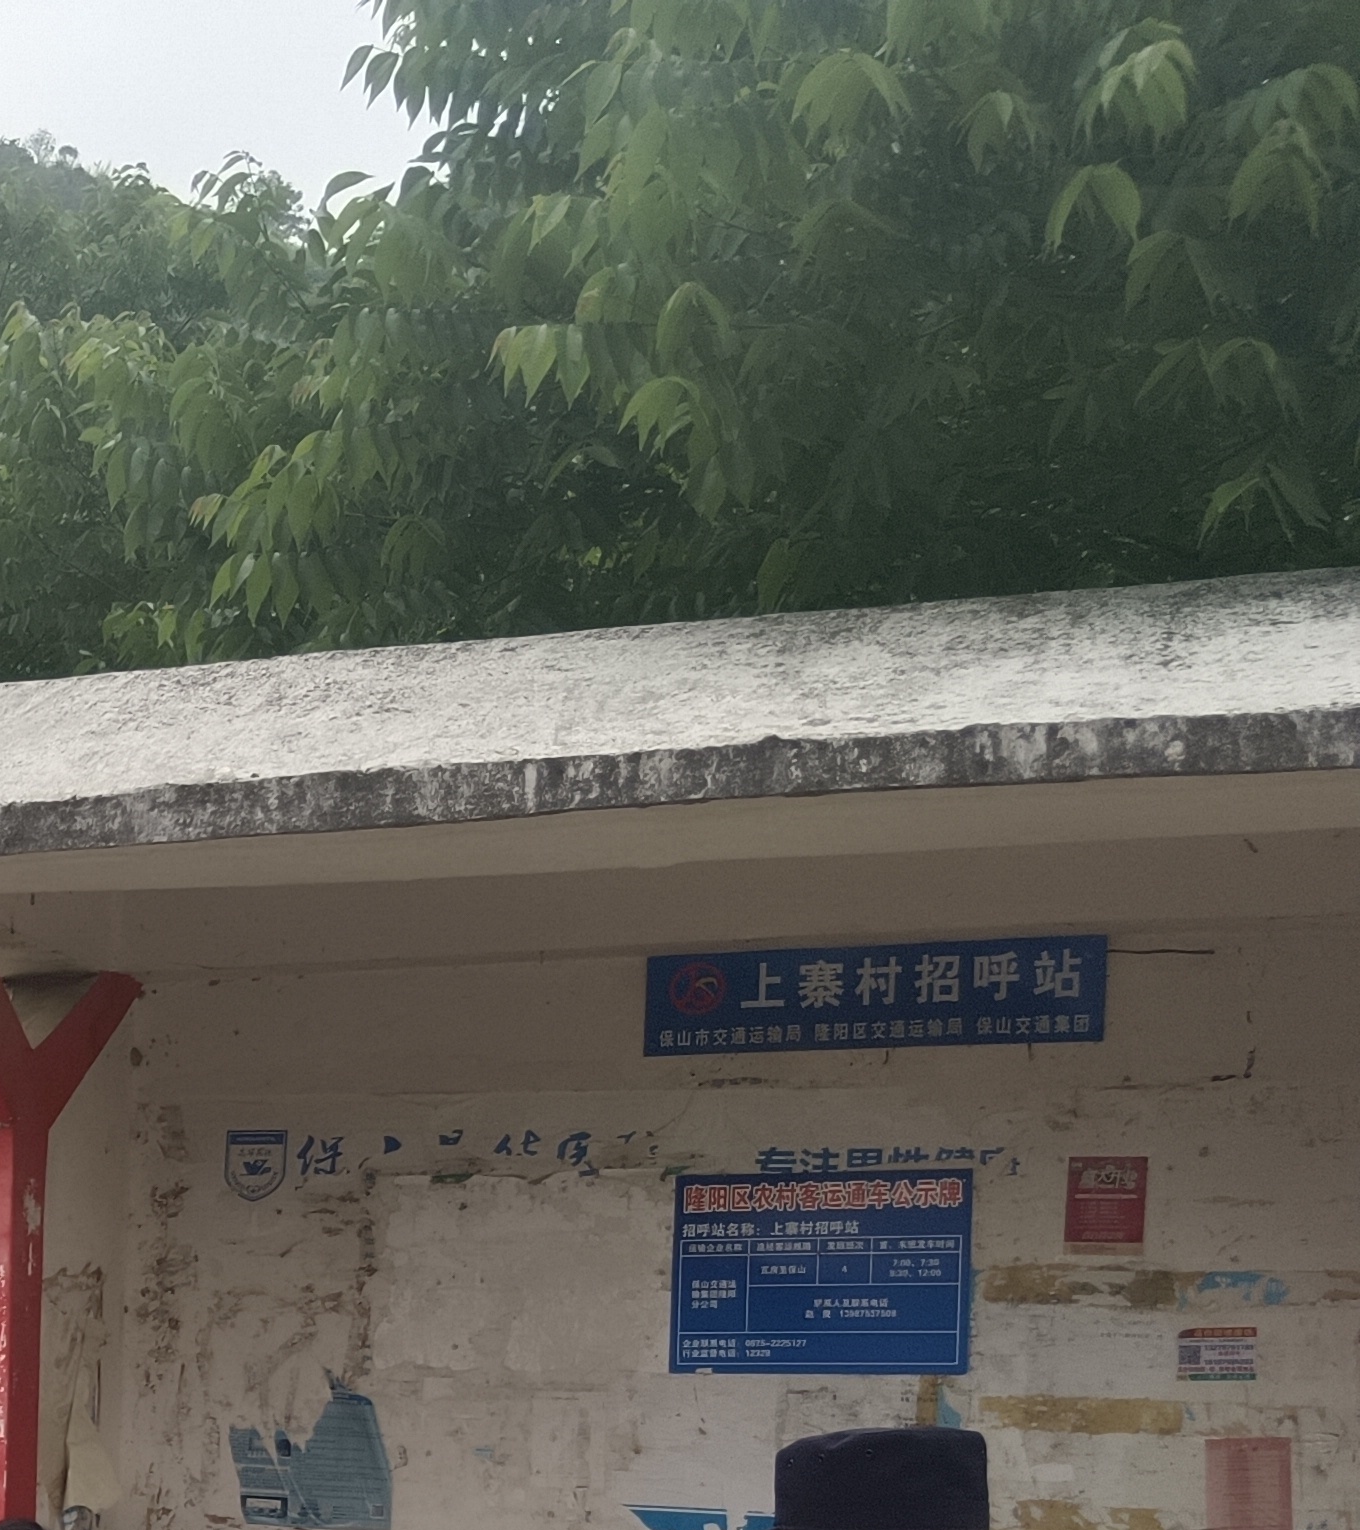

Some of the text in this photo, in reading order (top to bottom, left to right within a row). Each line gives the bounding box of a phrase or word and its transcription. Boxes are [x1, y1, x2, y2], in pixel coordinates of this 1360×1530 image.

[741, 948, 1083, 1009] 上寨村招呼站
[659, 1014, 1091, 1048] 保山市交通运输局 隆阳区交通运输局 保山交通集团
[683, 1178, 963, 1213] 隆阳区农村客运通车公示牌
